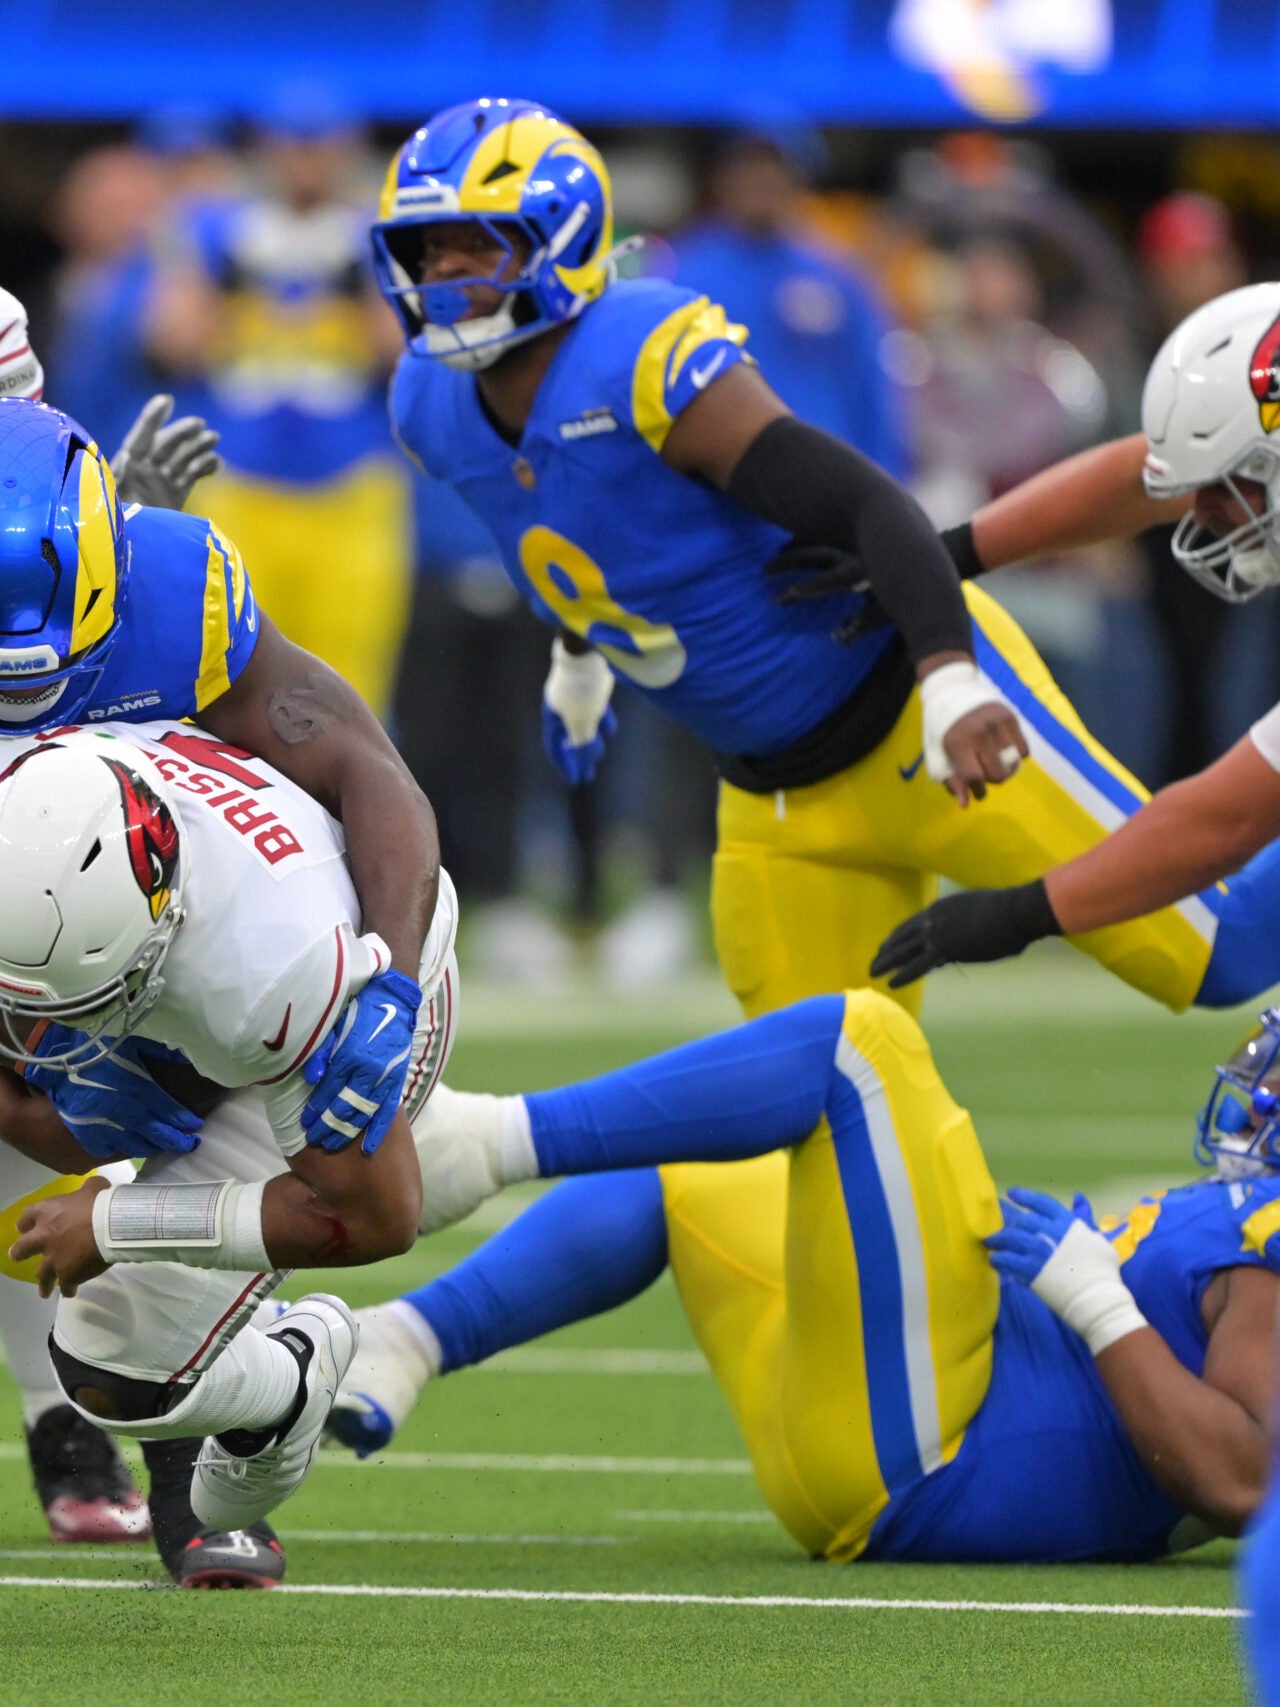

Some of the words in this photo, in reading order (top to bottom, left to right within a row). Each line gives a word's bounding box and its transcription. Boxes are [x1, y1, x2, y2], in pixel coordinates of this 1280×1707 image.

[518, 525, 687, 689] 8
[87, 695, 162, 720] RAMS
[138, 745, 304, 865] BRISS
